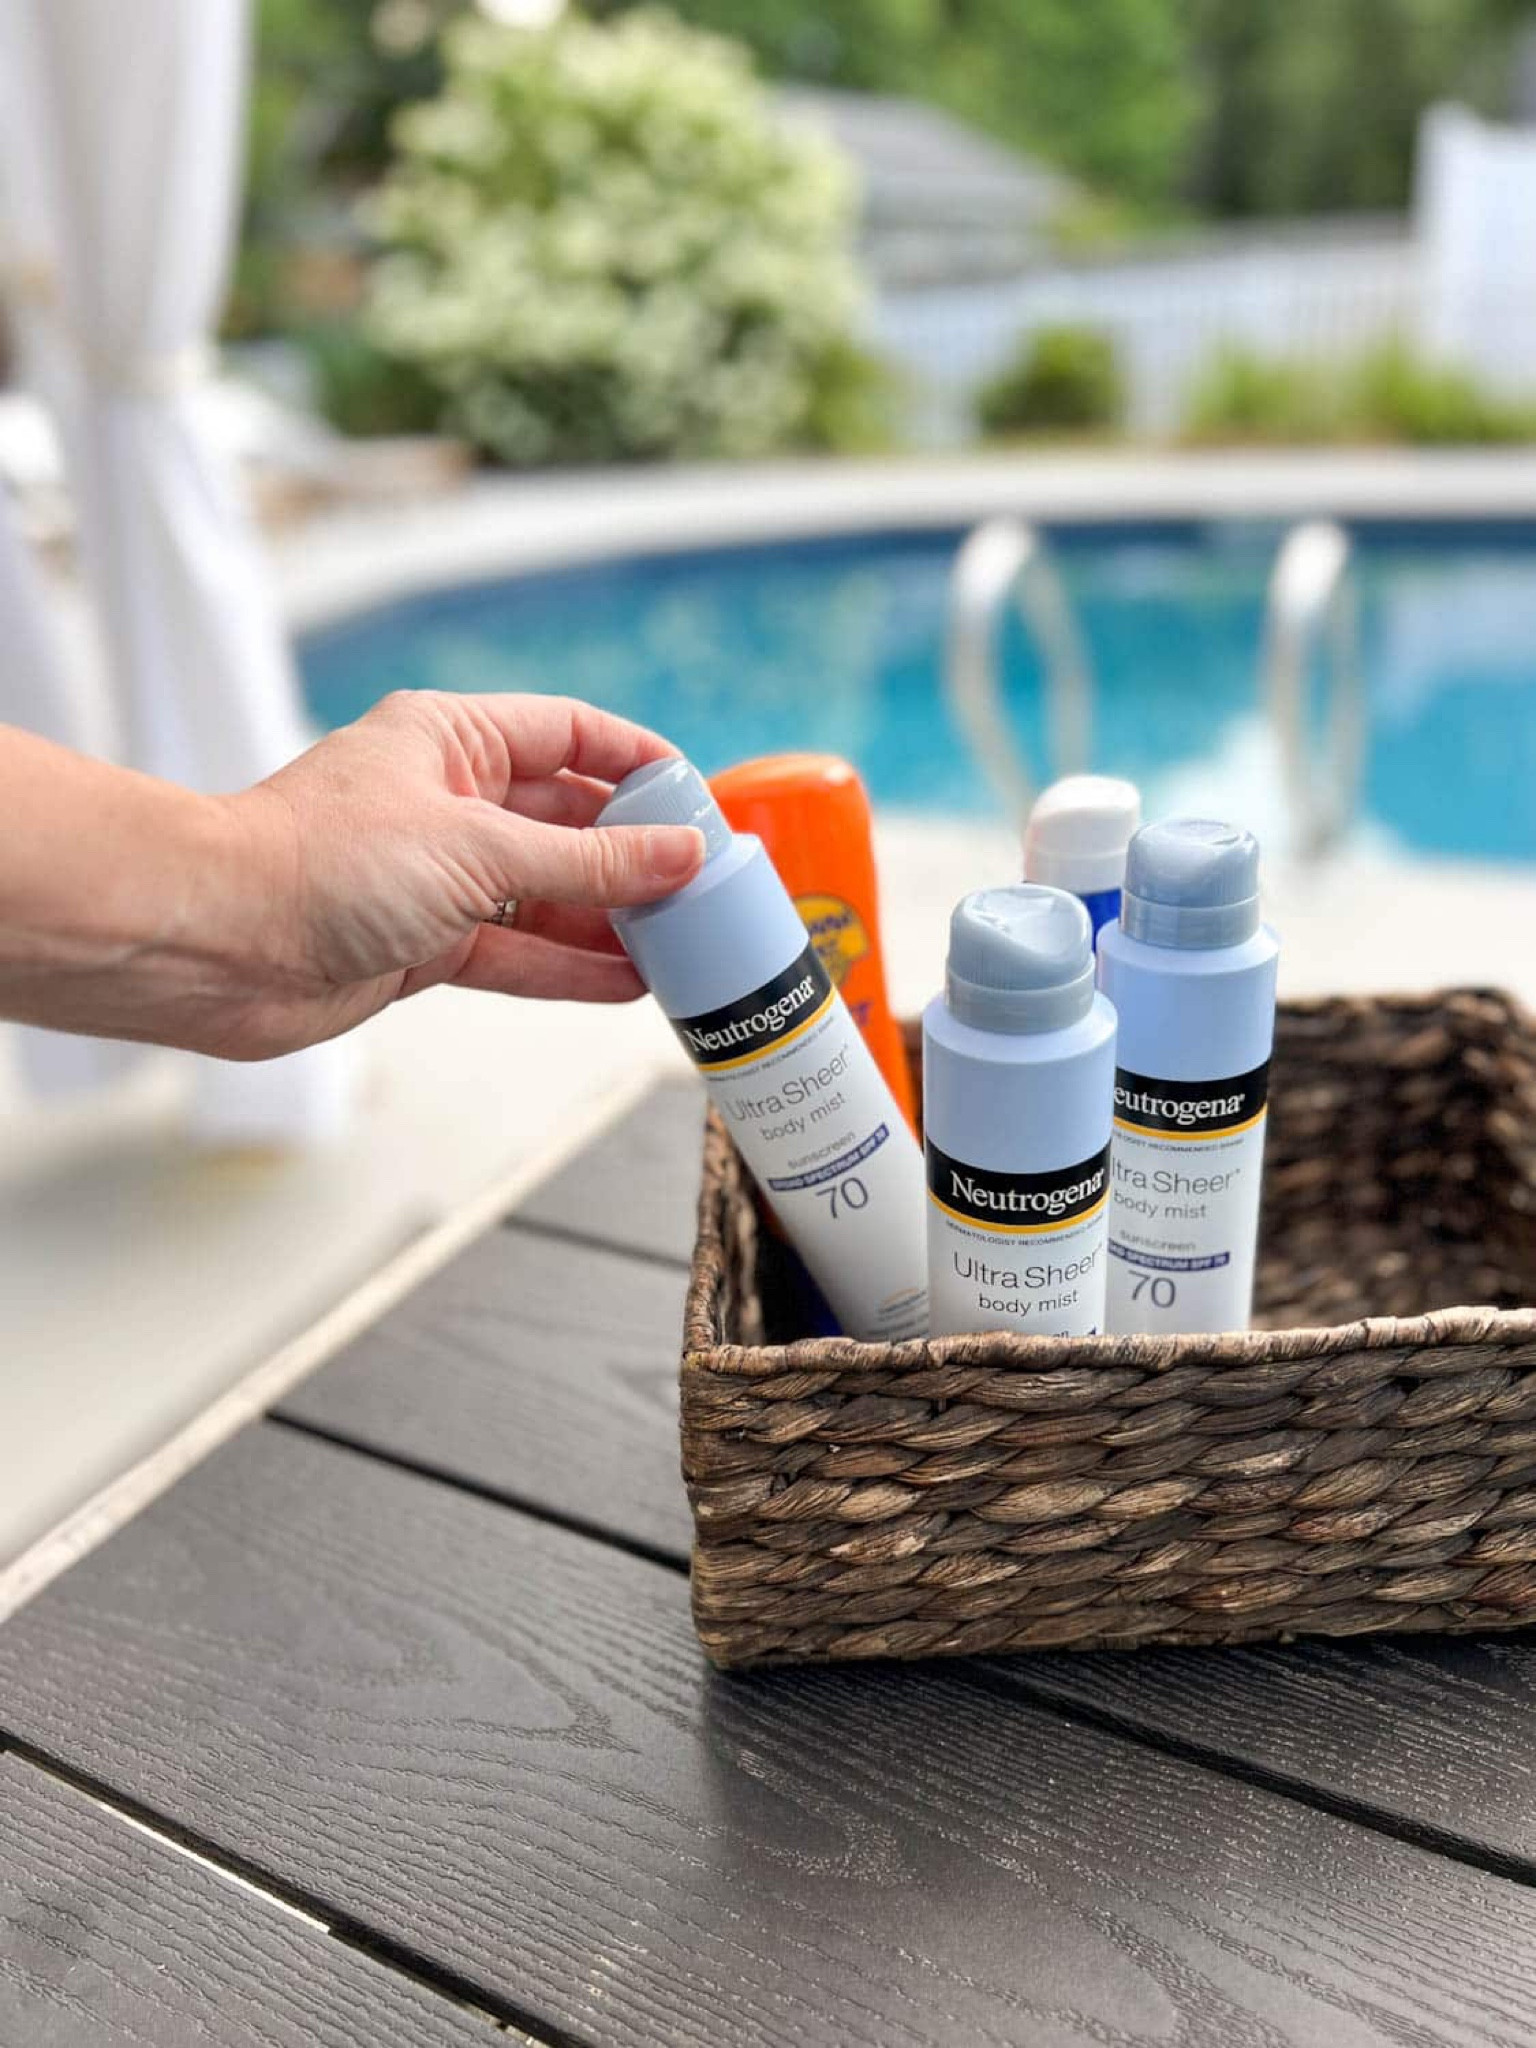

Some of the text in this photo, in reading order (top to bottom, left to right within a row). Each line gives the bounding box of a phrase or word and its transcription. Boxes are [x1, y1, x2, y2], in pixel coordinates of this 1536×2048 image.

[684, 977, 815, 1050] Neutrogena
[725, 1050, 848, 1121] Ultra Sheer
[761, 1092, 846, 1141] body mist
[1114, 1086, 1242, 1125] eutrogena
[950, 1169, 1103, 1215] Neutrogena
[1112, 1157, 1232, 1195] ltra Sheer
[815, 1177, 869, 1219] 70
[1114, 1189, 1206, 1218] body mist
[954, 1251, 1019, 1288] Ultra
[1024, 1250, 1097, 1289] Sheer
[1128, 1269, 1176, 1308] 70
[979, 1290, 1078, 1316] body mist
